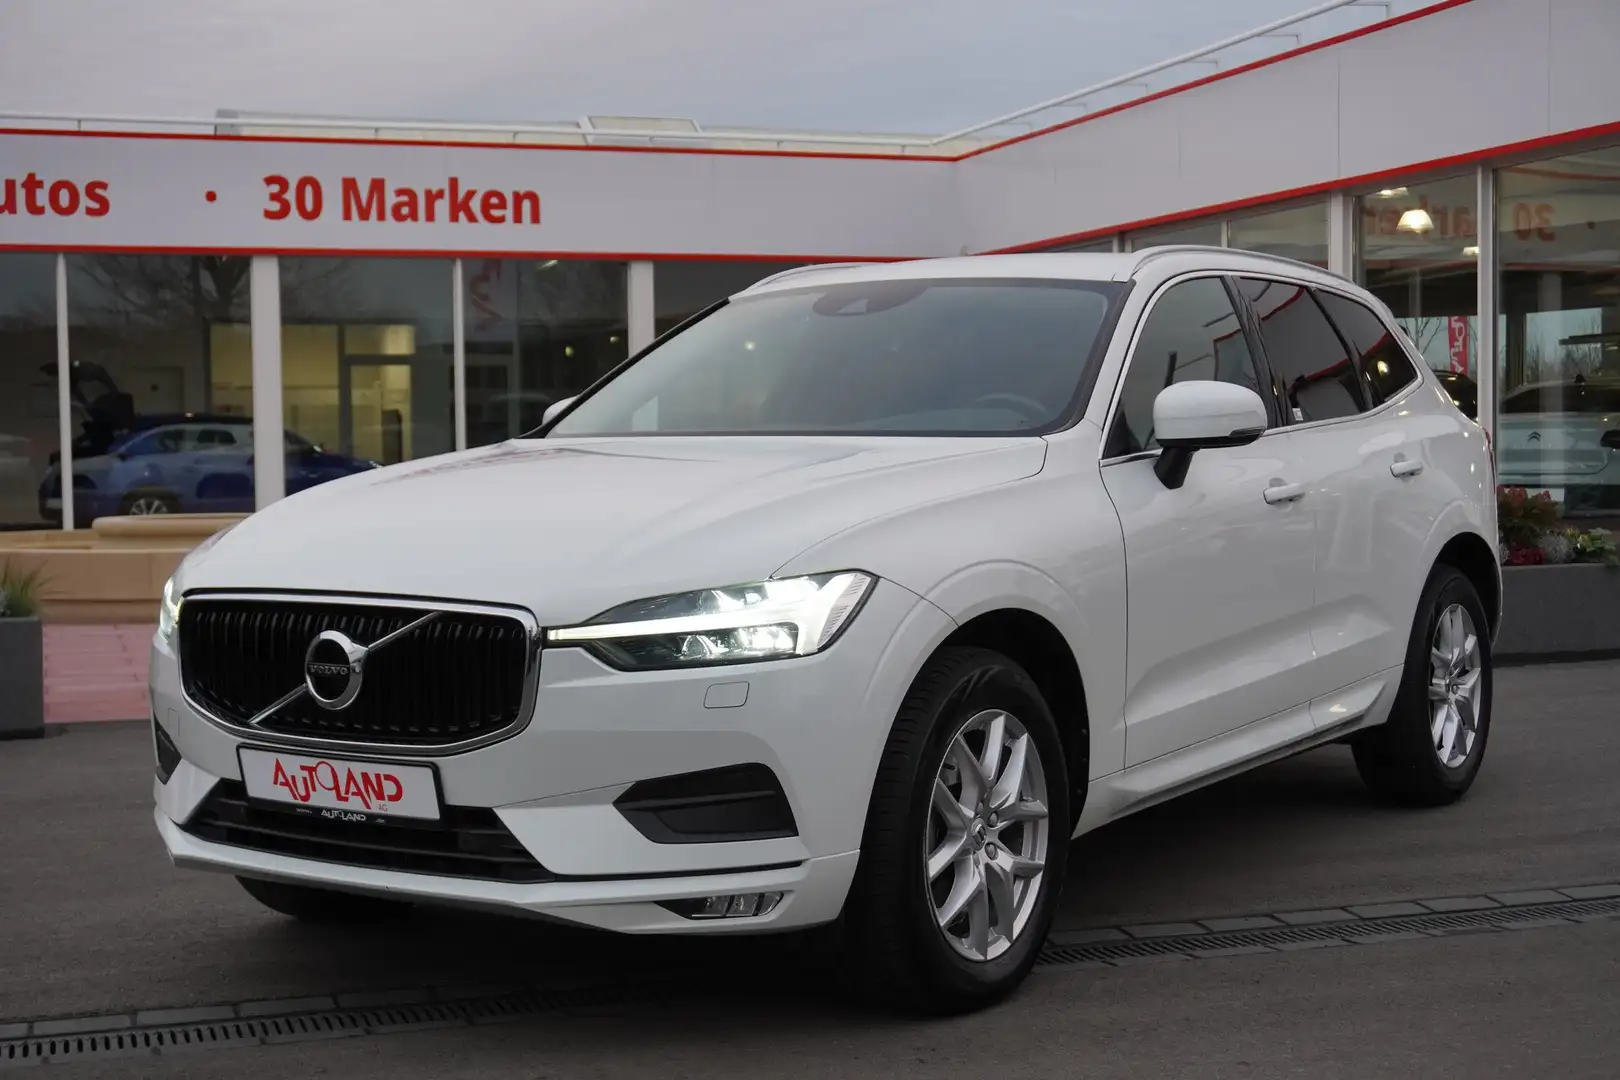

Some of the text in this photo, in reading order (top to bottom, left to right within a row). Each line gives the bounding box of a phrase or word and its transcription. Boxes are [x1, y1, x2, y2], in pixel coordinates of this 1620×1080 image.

[263, 174, 323, 221] 30
[342, 176, 541, 225] Marken
[308, 664, 348, 675] VOLVO
[273, 758, 403, 809] AUTOLAND
[321, 809, 366, 821] AUTOLAND
